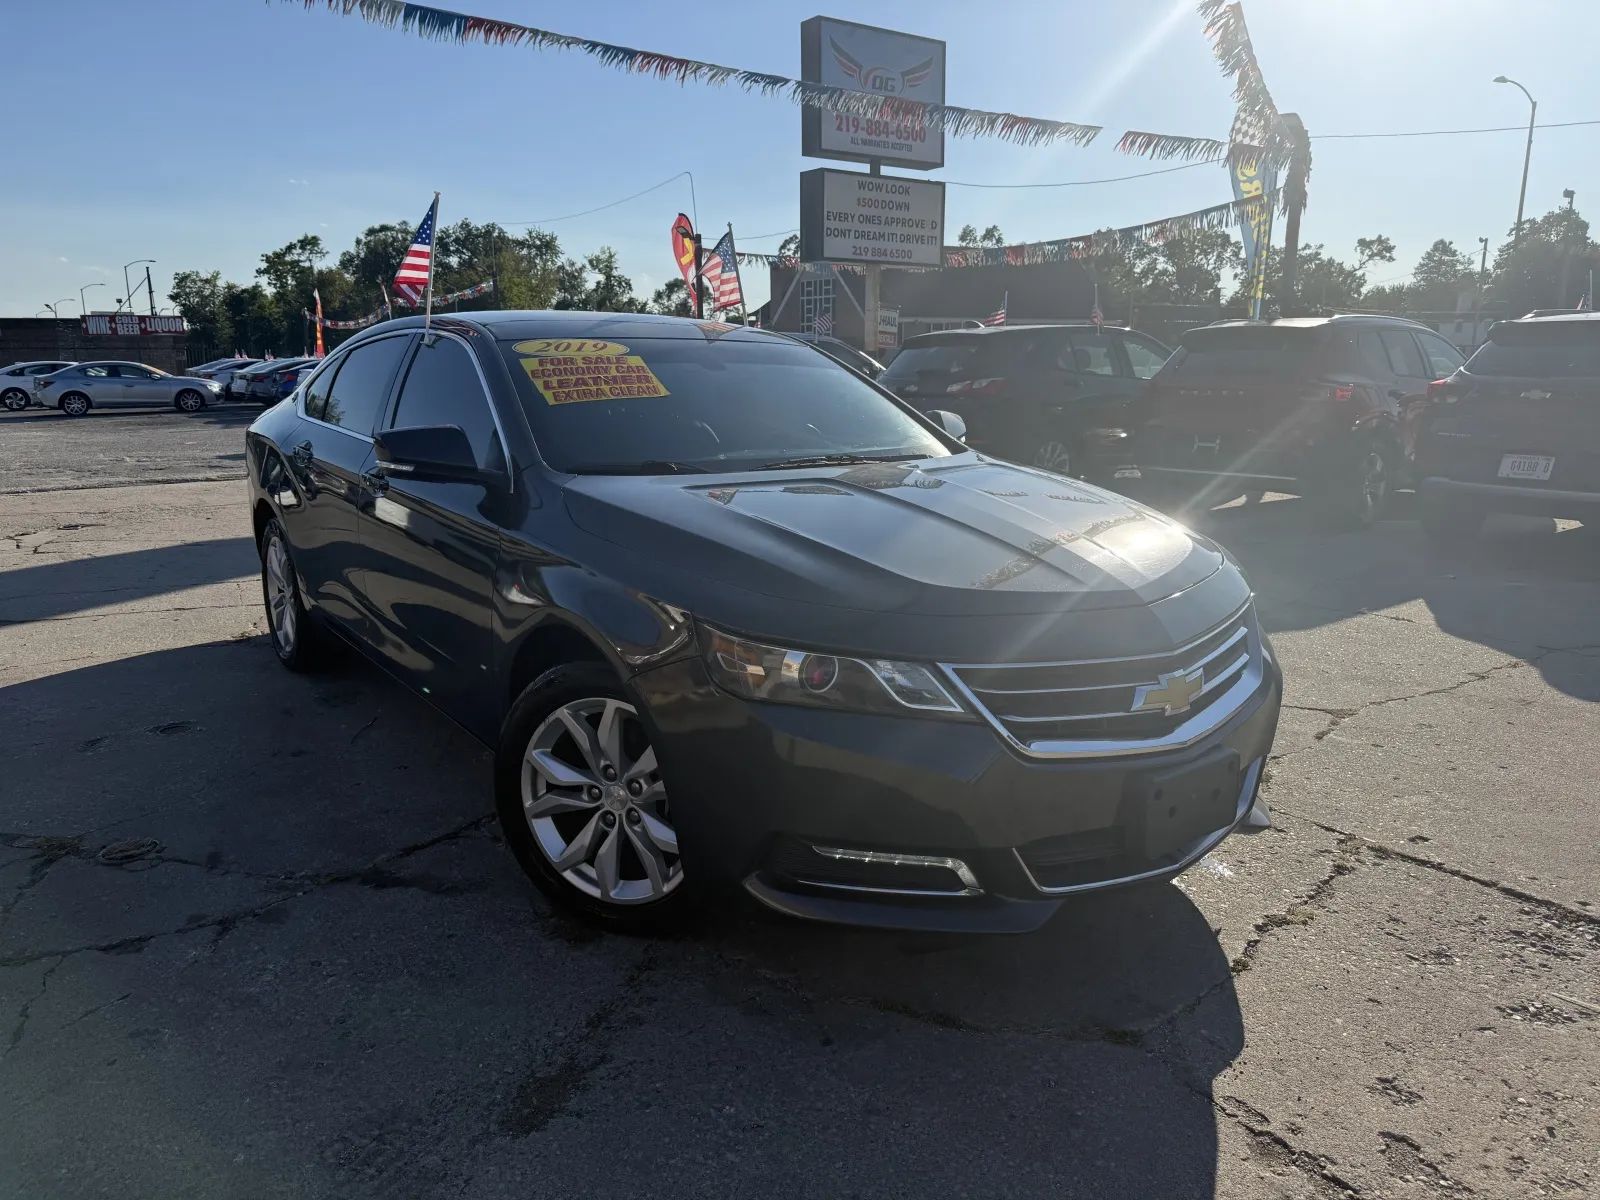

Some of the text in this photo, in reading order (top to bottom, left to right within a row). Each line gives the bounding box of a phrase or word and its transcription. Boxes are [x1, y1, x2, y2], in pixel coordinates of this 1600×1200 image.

[857, 180, 911, 196] WOW LOOK
[857, 197, 910, 212] $500 DOWN
[826, 211, 855, 223] EVERY
[858, 214, 882, 225] ONES
[826, 227, 852, 239] DONT
[854, 230, 886, 242] DREAM
[888, 233, 898, 243] IT!
[900, 234, 927, 245] DRIVE
[852, 246, 912, 260] 219 884 6500
[85, 316, 112, 335] WINE
[115, 315, 139, 324] COLD
[145, 318, 183, 333] LIQUOR
[116, 323, 140, 335] BEER
[534, 341, 608, 353] 2019
[538, 356, 628, 367] FOR SALE
[531, 365, 648, 379] ECONOMY CAR
[543, 374, 653, 390] LEATHER
[552, 384, 661, 402] EXTRA CLEAN
